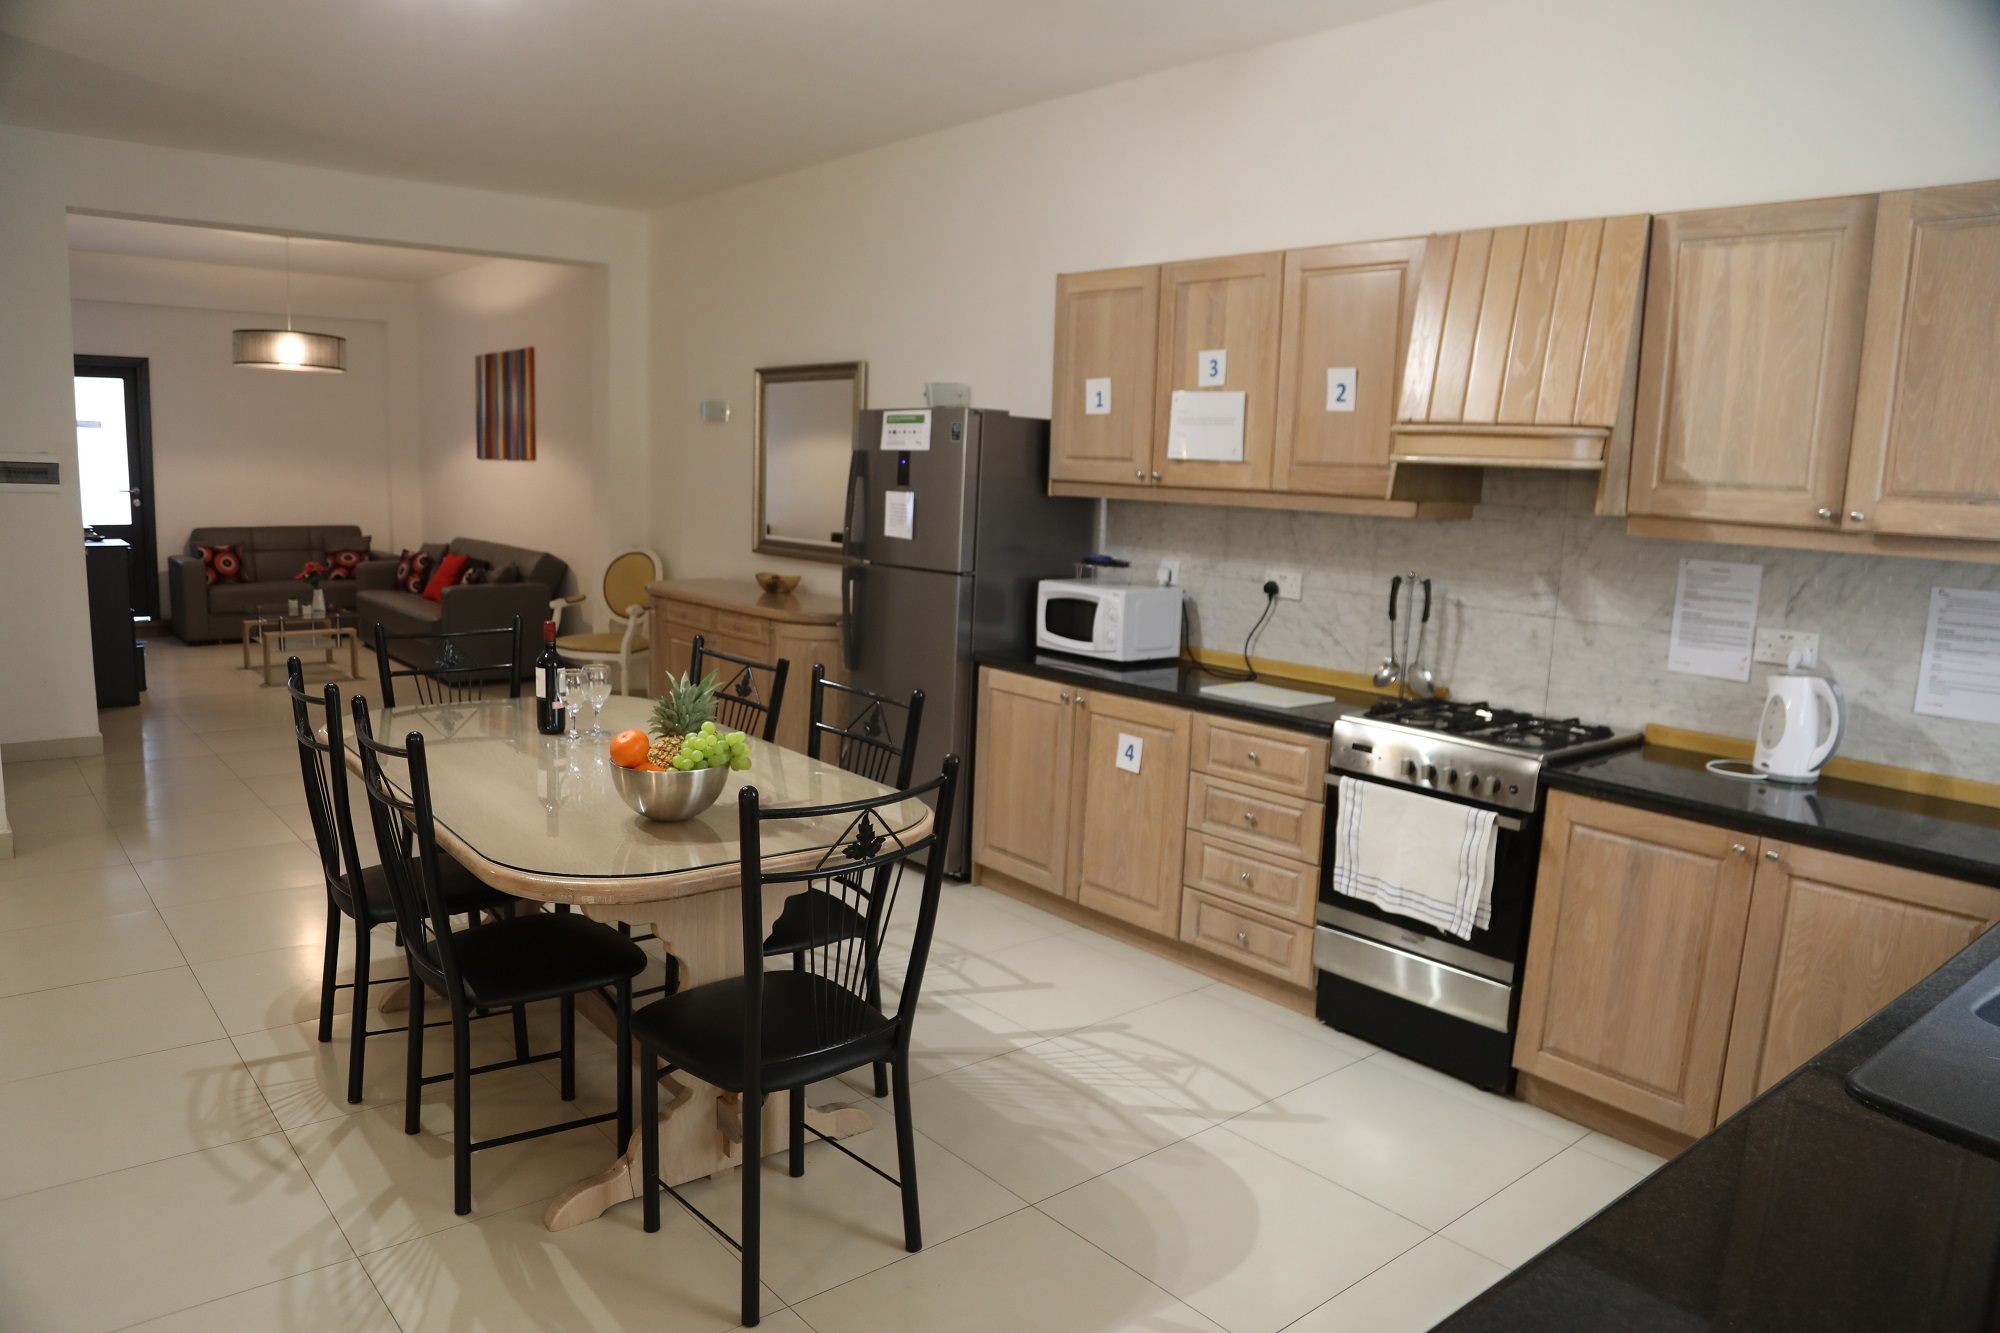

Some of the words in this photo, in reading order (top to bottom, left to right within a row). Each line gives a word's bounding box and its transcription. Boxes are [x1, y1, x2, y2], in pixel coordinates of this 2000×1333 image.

[1209, 359, 1218, 377] 3
[1096, 391, 1104, 408] 1
[1336, 383, 1346, 402] 2
[1125, 744, 1135, 761] 4
